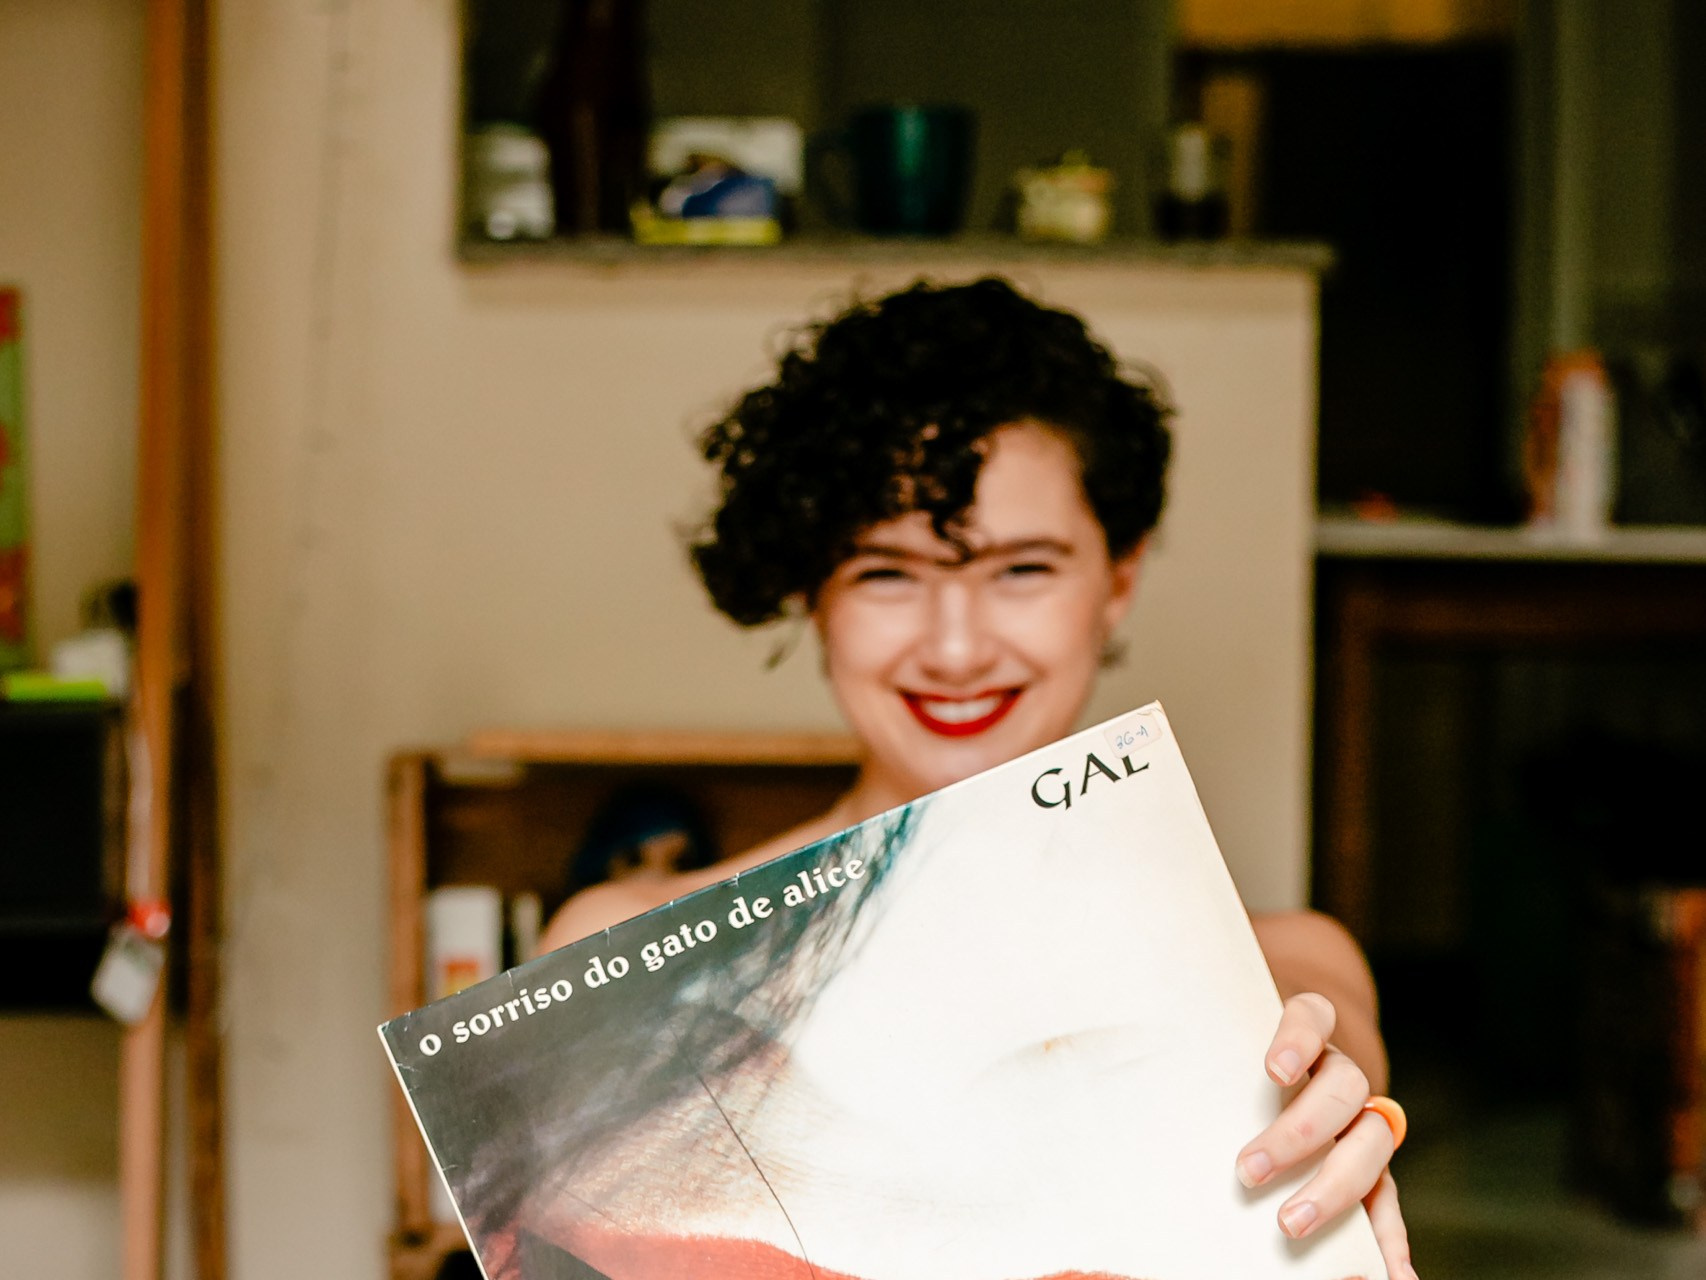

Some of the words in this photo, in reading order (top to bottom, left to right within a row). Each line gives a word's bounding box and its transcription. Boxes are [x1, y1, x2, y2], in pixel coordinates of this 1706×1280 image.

[1031, 752, 1150, 810] GAL
[419, 1033, 442, 1057] o
[452, 979, 573, 1044] sorriso
[583, 955, 630, 989] do
[640, 919, 718, 973] gato
[727, 896, 774, 930] de
[782, 858, 866, 908] alice
